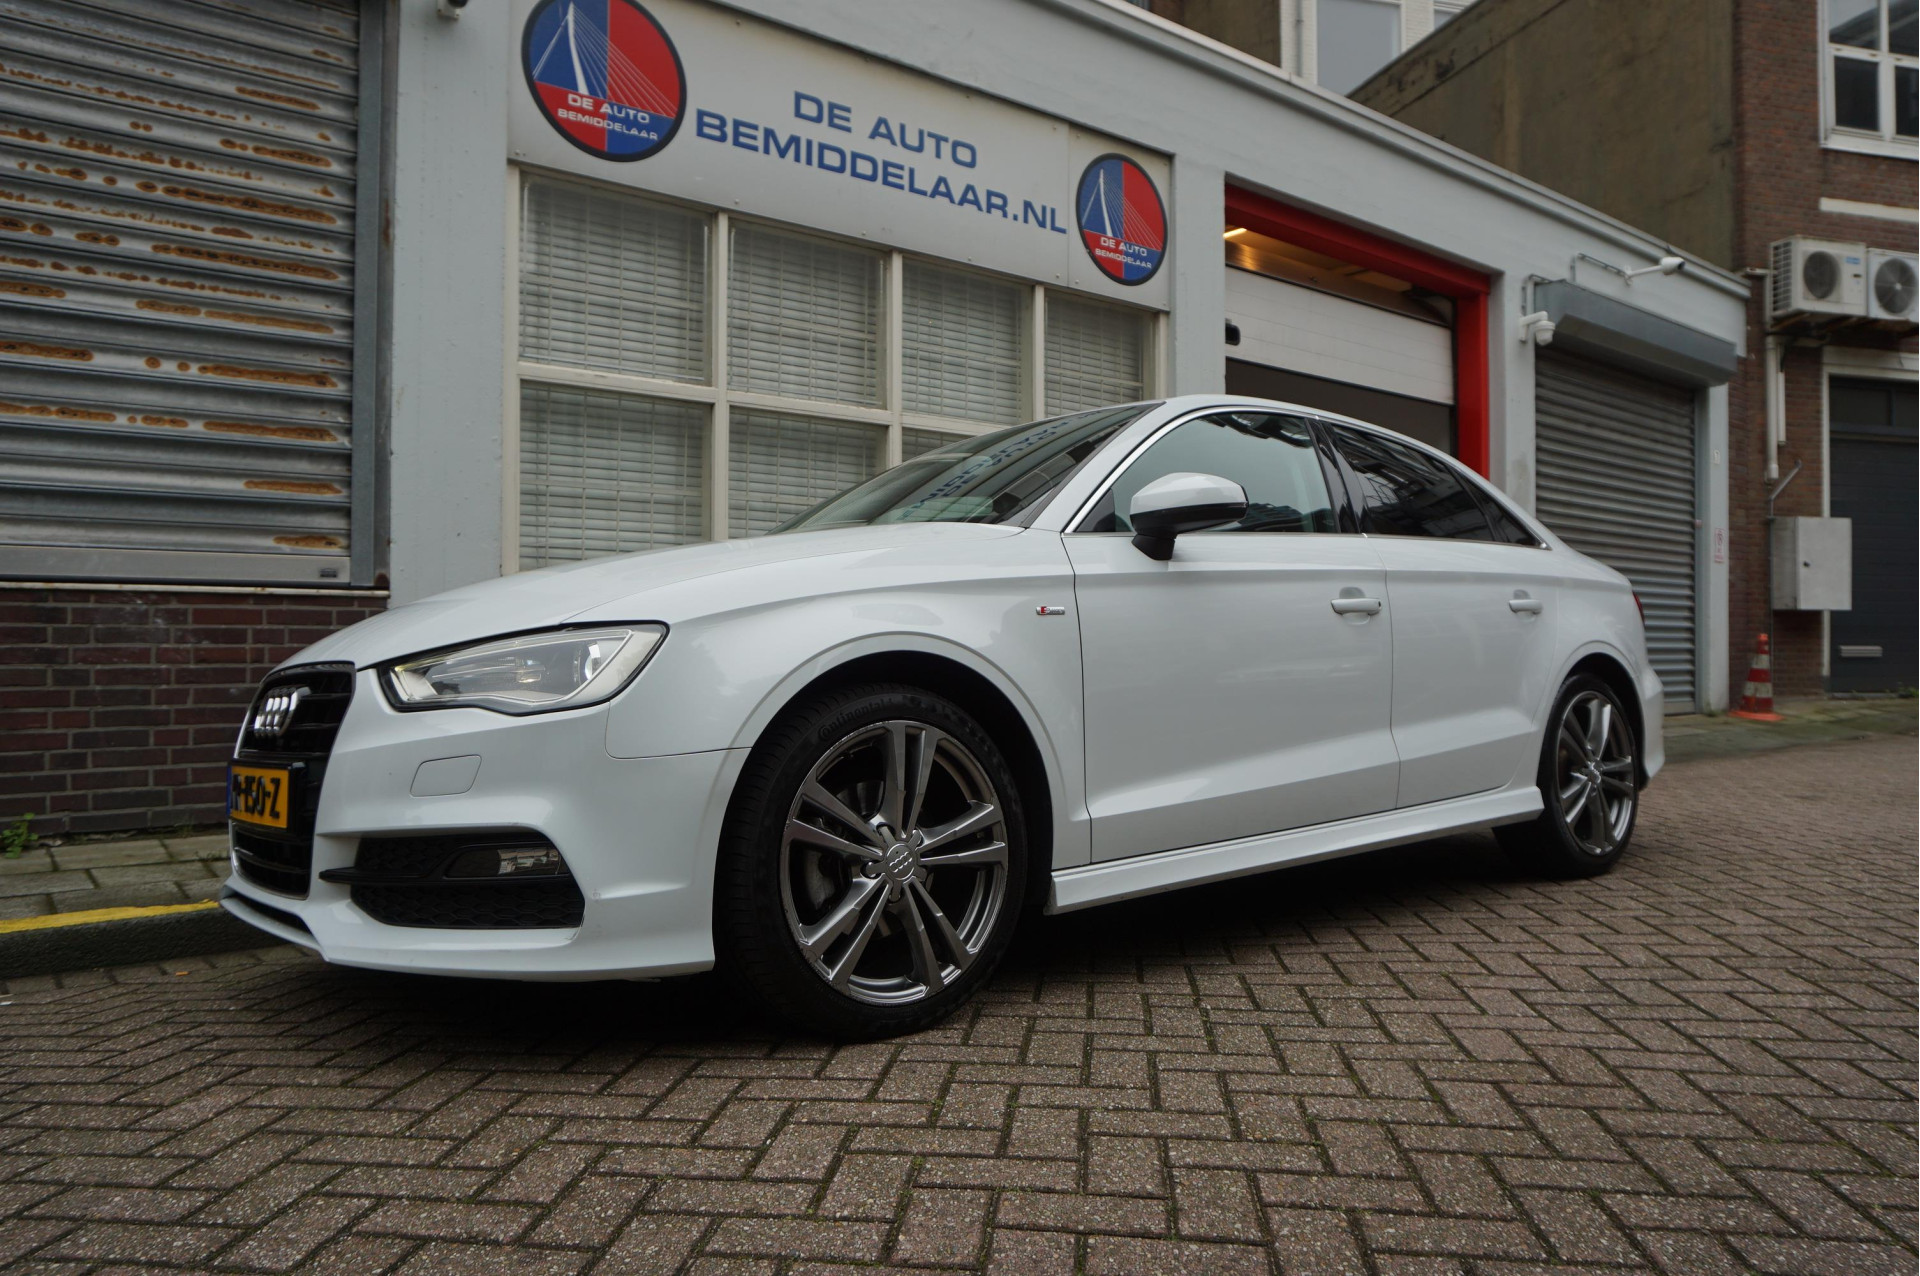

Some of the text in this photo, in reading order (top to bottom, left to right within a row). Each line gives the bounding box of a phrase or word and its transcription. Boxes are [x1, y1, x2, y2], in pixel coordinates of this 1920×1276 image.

[557, 108, 658, 140] BEMIDDELAAR
[568, 94, 650, 124] DE AUTO
[794, 90, 977, 169] DE AUTO
[696, 108, 1067, 234] BEMIDDELAAR.NL
[1095, 248, 1151, 268] BEMIDDELAAR
[1101, 237, 1147, 256] DE AUTO
[818, 698, 886, 740] Continental
